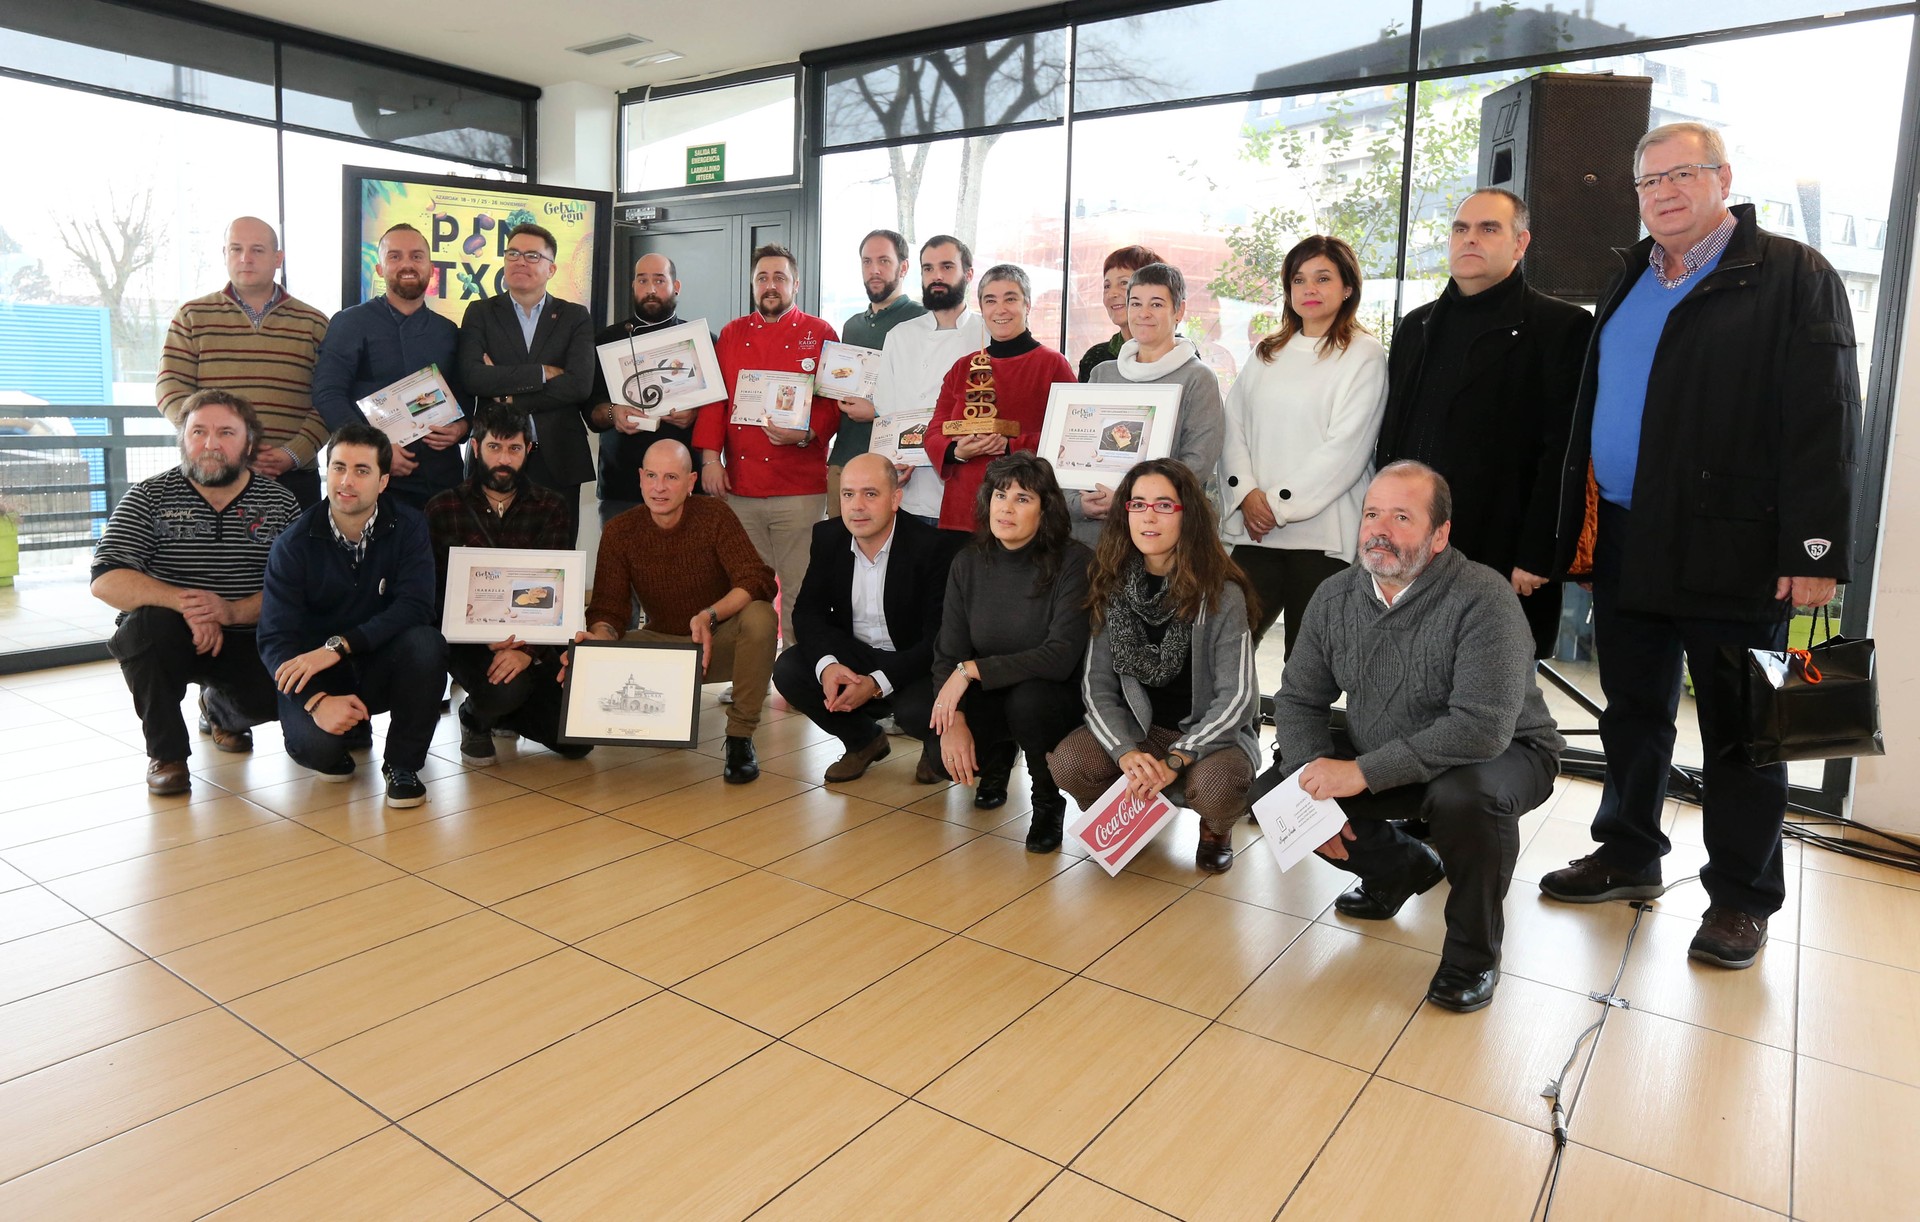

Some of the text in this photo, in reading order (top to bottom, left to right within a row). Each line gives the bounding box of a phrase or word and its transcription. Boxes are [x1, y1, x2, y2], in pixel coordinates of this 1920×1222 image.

[692, 155, 720, 164] EMERGENCIA
[560, 212, 584, 227] egin
[1810, 544, 1823, 556] 53
